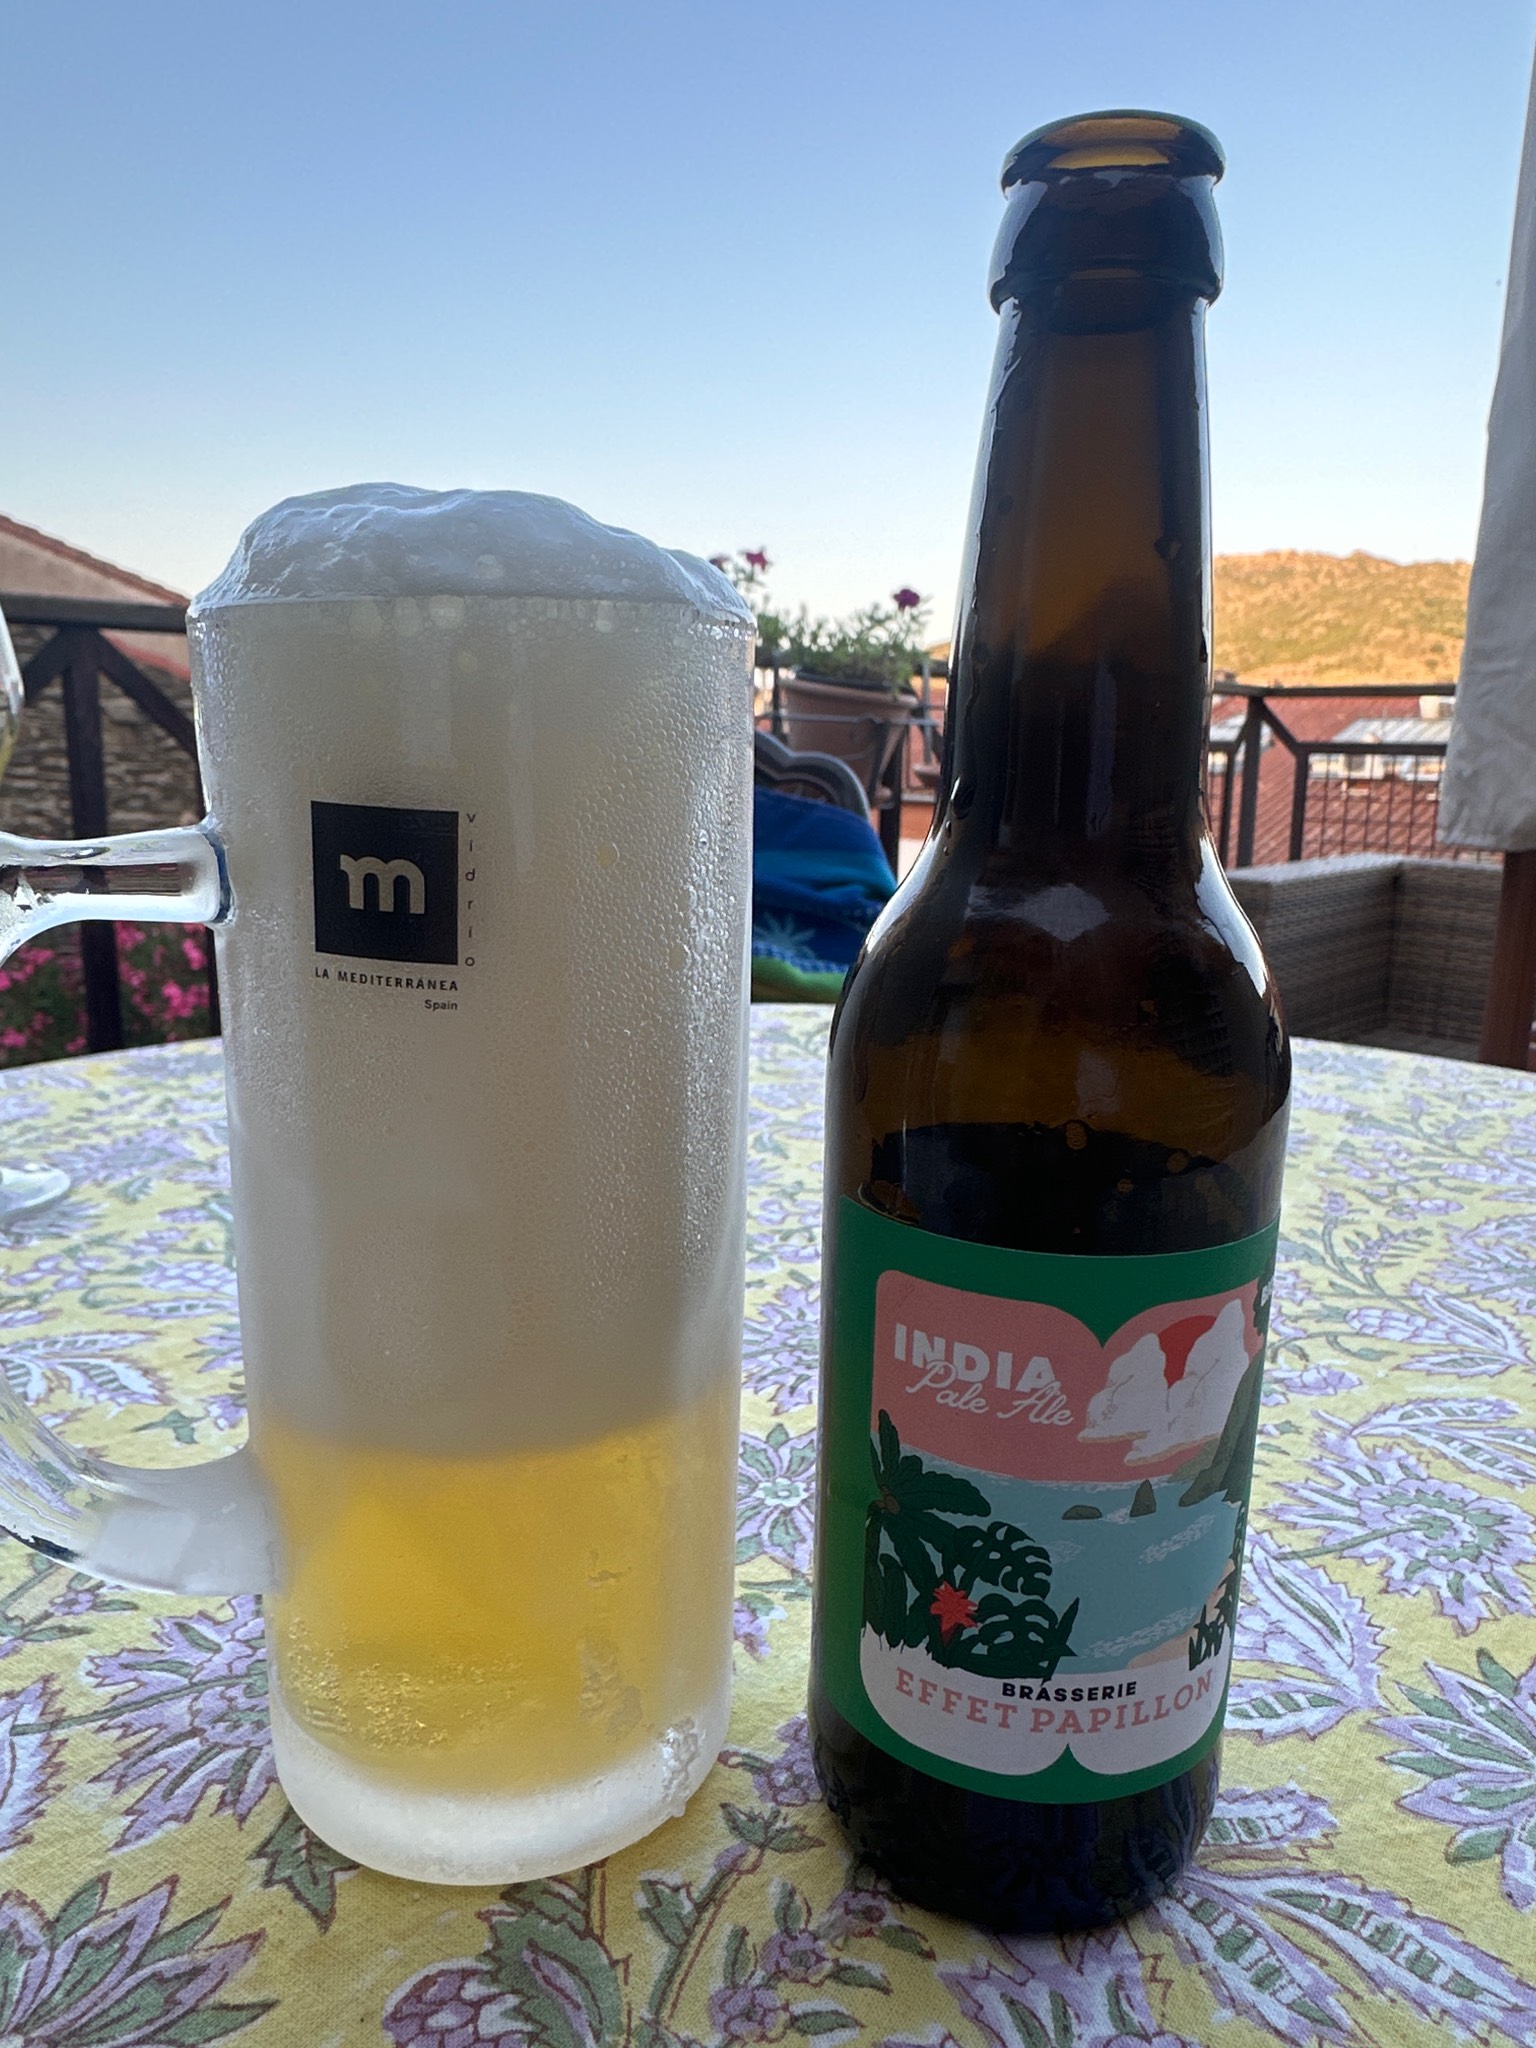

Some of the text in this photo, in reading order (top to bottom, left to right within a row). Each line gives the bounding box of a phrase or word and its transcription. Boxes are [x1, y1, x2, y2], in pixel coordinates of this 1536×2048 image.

[340, 853, 426, 915] m
[314, 967, 330, 980] LA
[424, 999, 459, 1012] Spain
[894, 1323, 1060, 1394] INDIA
[906, 1359, 1073, 1426] Pale Ale
[895, 1666, 1213, 1735] EFFET PAPILLON
[1002, 1681, 1137, 1702] BRASSERIE
